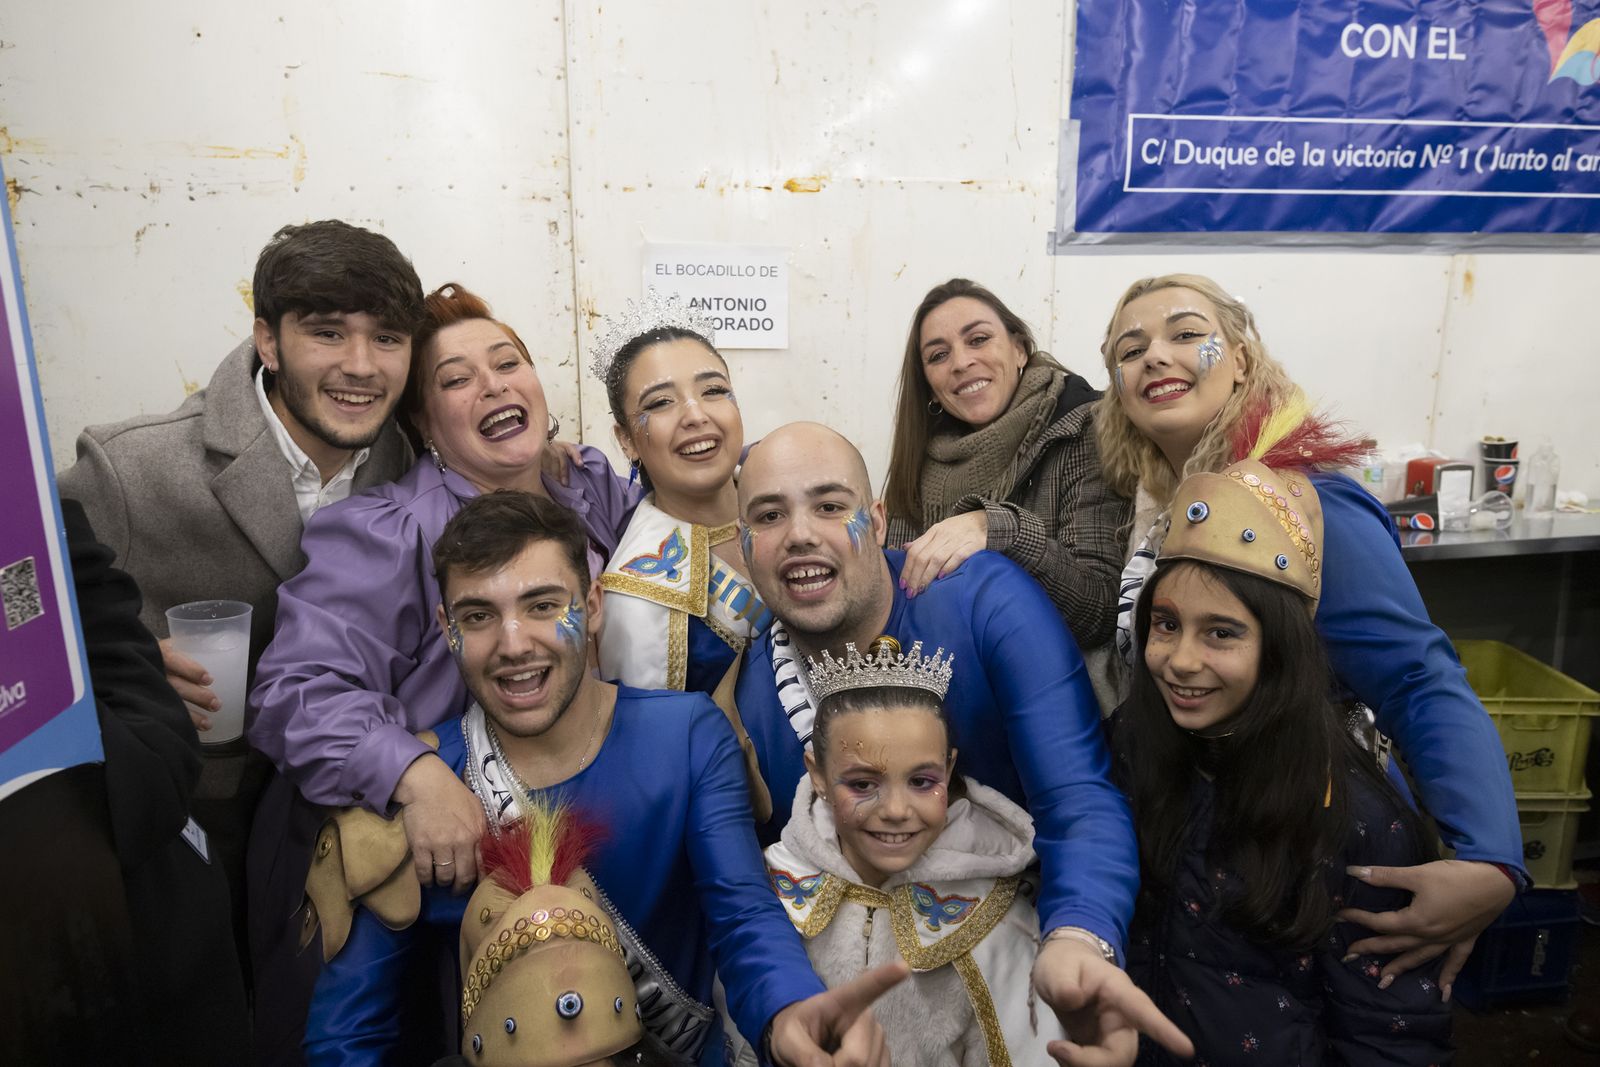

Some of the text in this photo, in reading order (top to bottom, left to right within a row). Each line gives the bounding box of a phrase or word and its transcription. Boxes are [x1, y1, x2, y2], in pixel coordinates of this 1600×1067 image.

[1340, 22, 1467, 61] CON EL
[1141, 137, 1167, 166] C/
[1173, 138, 1259, 170] Duque
[1264, 140, 1296, 166] de
[1302, 141, 1326, 167] la
[1332, 143, 1416, 168] victoria
[1459, 147, 1469, 170] 1
[1552, 147, 1573, 172] al
[655, 263, 779, 278] EL BOCADILLO DE
[689, 296, 768, 312] ANTONIO
[711, 316, 775, 331] ORADO
